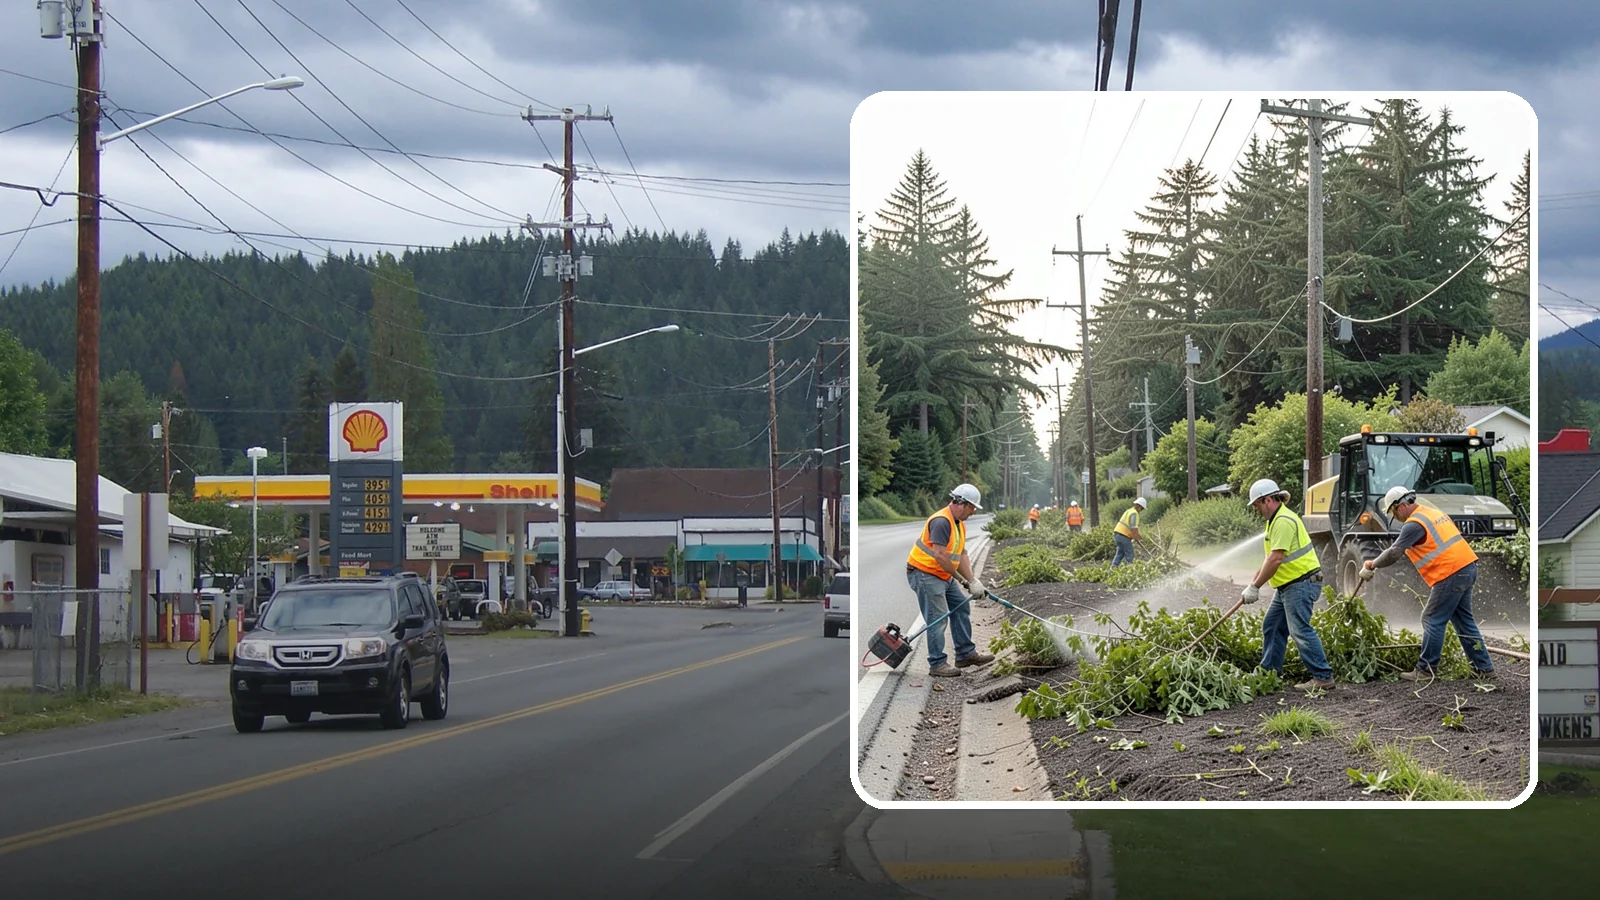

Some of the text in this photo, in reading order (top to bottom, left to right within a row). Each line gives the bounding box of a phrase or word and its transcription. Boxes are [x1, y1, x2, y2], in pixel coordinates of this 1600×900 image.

[366, 480, 384, 490] 395
[490, 484, 547, 499] Shell
[366, 494, 384, 504] 405
[366, 508, 384, 518] 415
[366, 522, 384, 533] 429
[1538, 643, 1567, 665] AID
